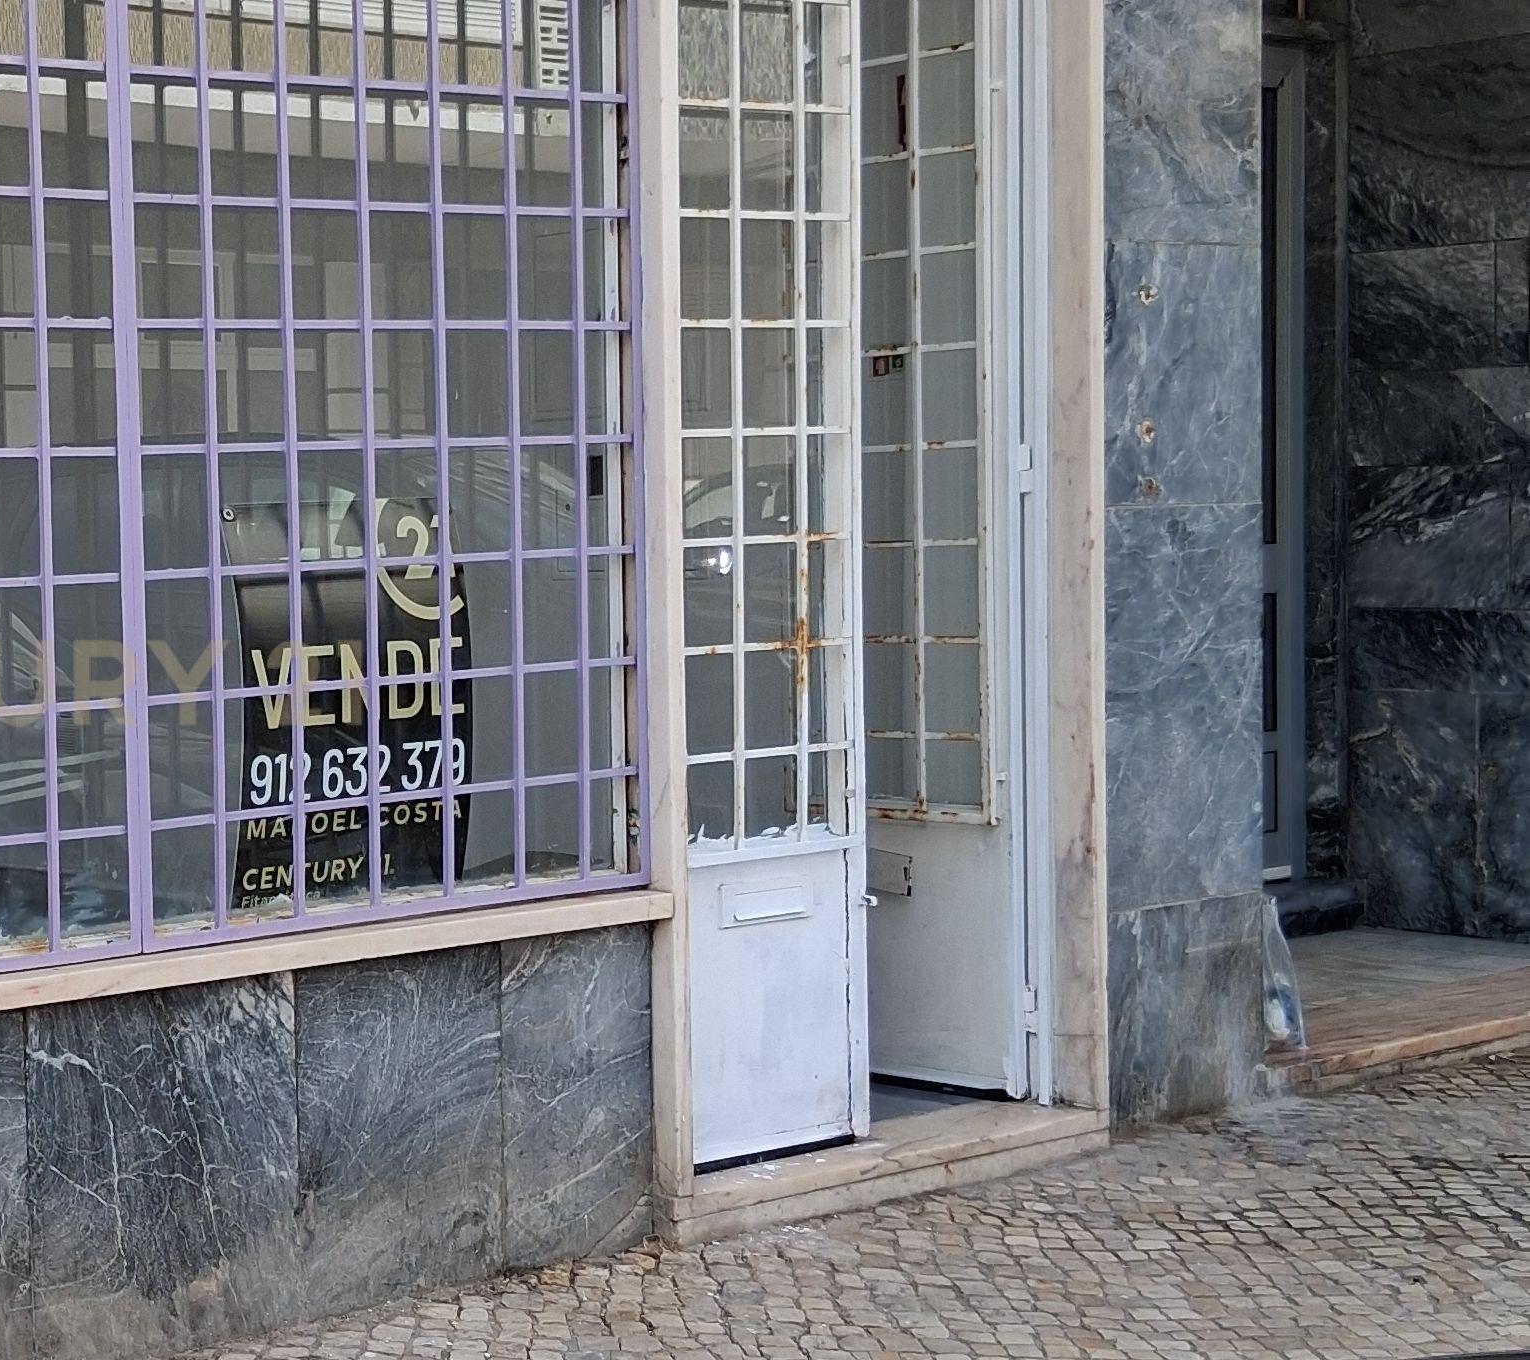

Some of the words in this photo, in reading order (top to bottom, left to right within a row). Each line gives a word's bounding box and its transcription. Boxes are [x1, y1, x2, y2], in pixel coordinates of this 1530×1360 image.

[251, 636, 465, 730] VENDE
[250, 752, 312, 806] 912
[322, 745, 392, 799] 632
[401, 738, 465, 791] 379
[246, 809, 362, 840] MAOEL
